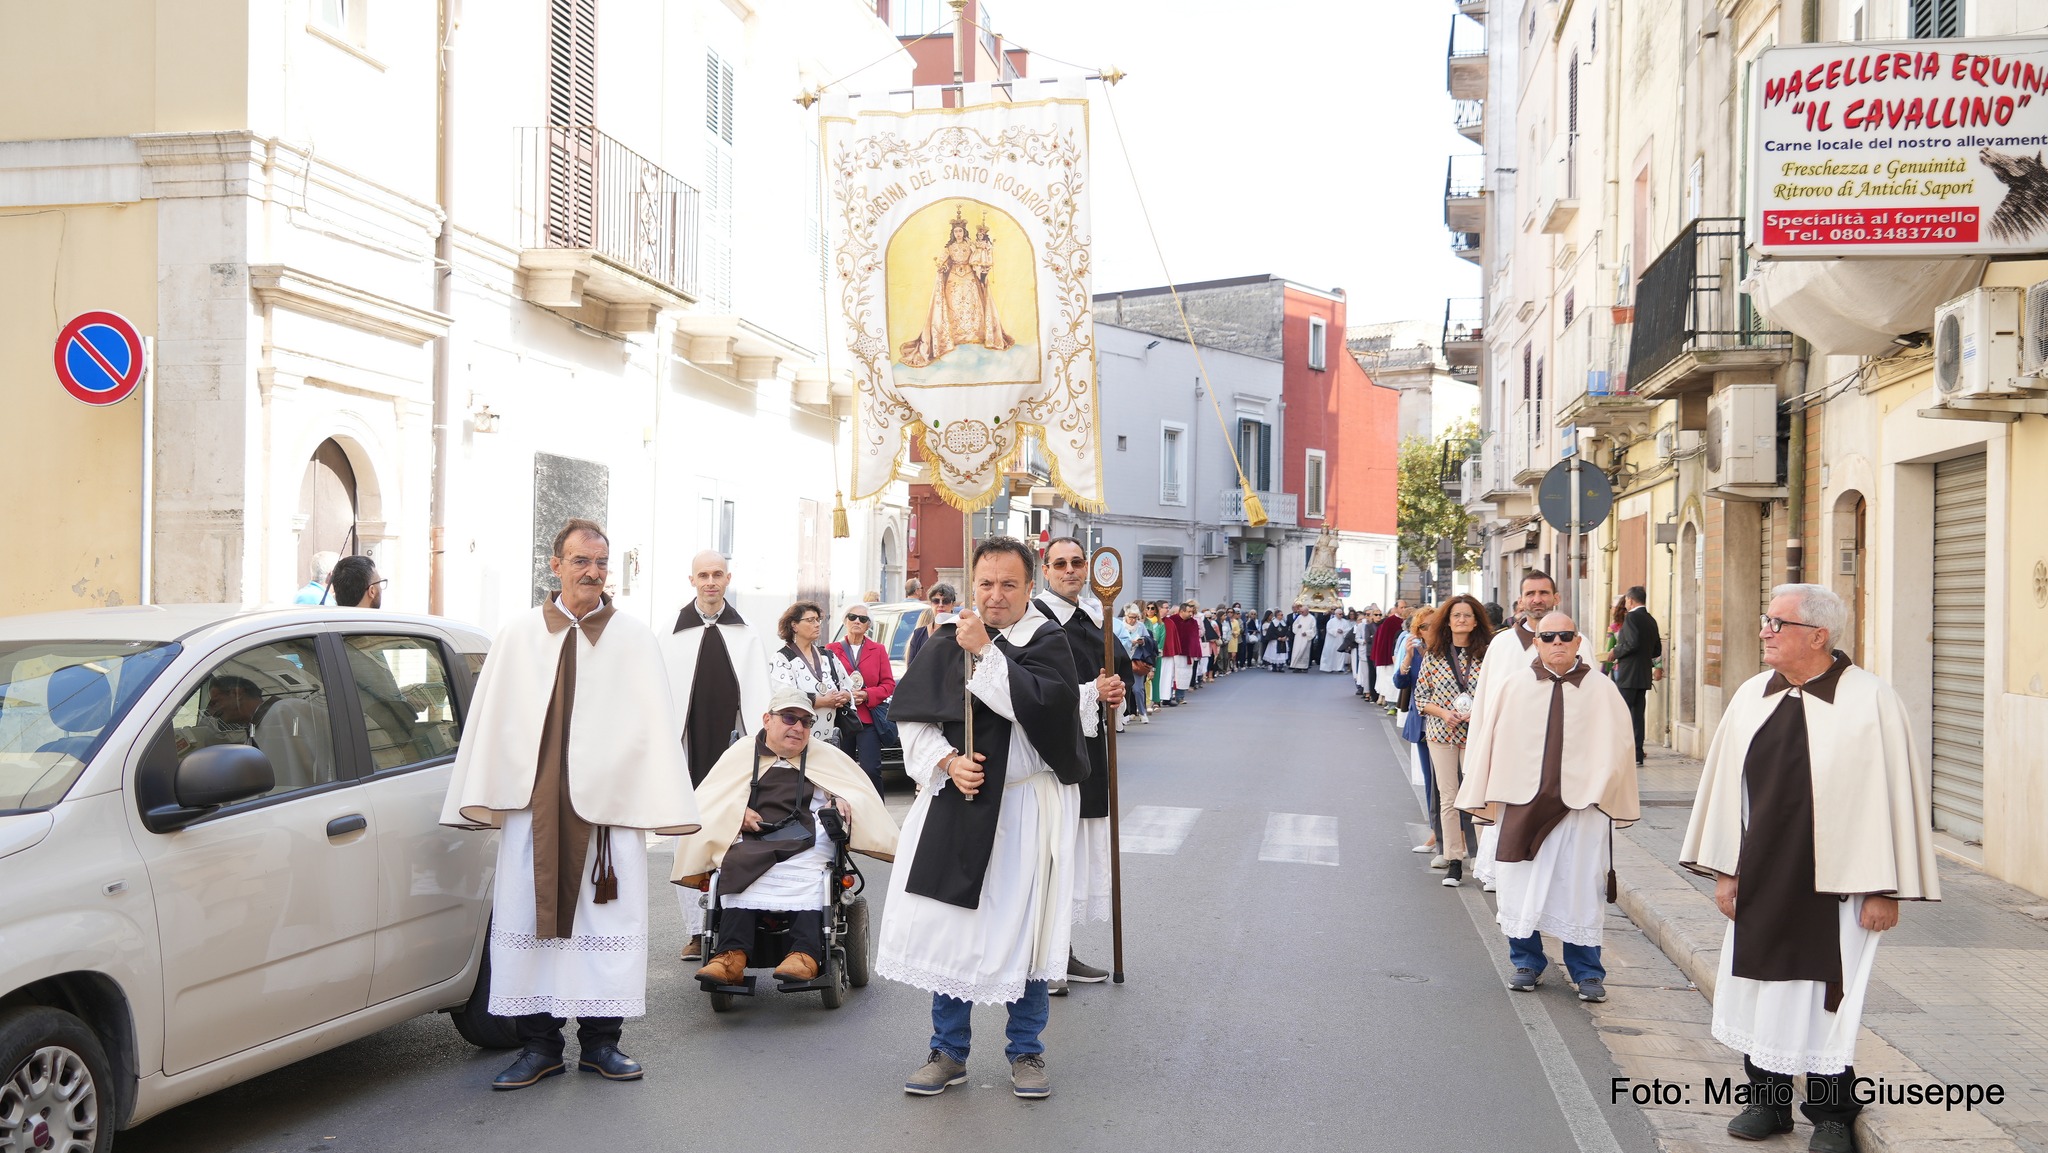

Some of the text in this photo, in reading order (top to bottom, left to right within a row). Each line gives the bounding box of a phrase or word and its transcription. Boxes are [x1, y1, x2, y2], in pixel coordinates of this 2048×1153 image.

[1764, 51, 1940, 109] MACELLERIA
[1764, 140, 1812, 151] Carne
[1817, 138, 1863, 150] locale
[1869, 137, 1893, 149] del
[1898, 137, 1951, 149] nostro
[1781, 157, 1966, 179] Freschezza e Genuinità
[909, 169, 937, 191] DEL
[943, 164, 989, 184] SANTO
[993, 173, 1049, 217] ROSARIO
[1773, 179, 1975, 200] Ritrovo di Antichi Sapori
[1766, 211, 1976, 229] Specialità al fornello
[1785, 227, 1957, 241] Tel. 080.3483740
